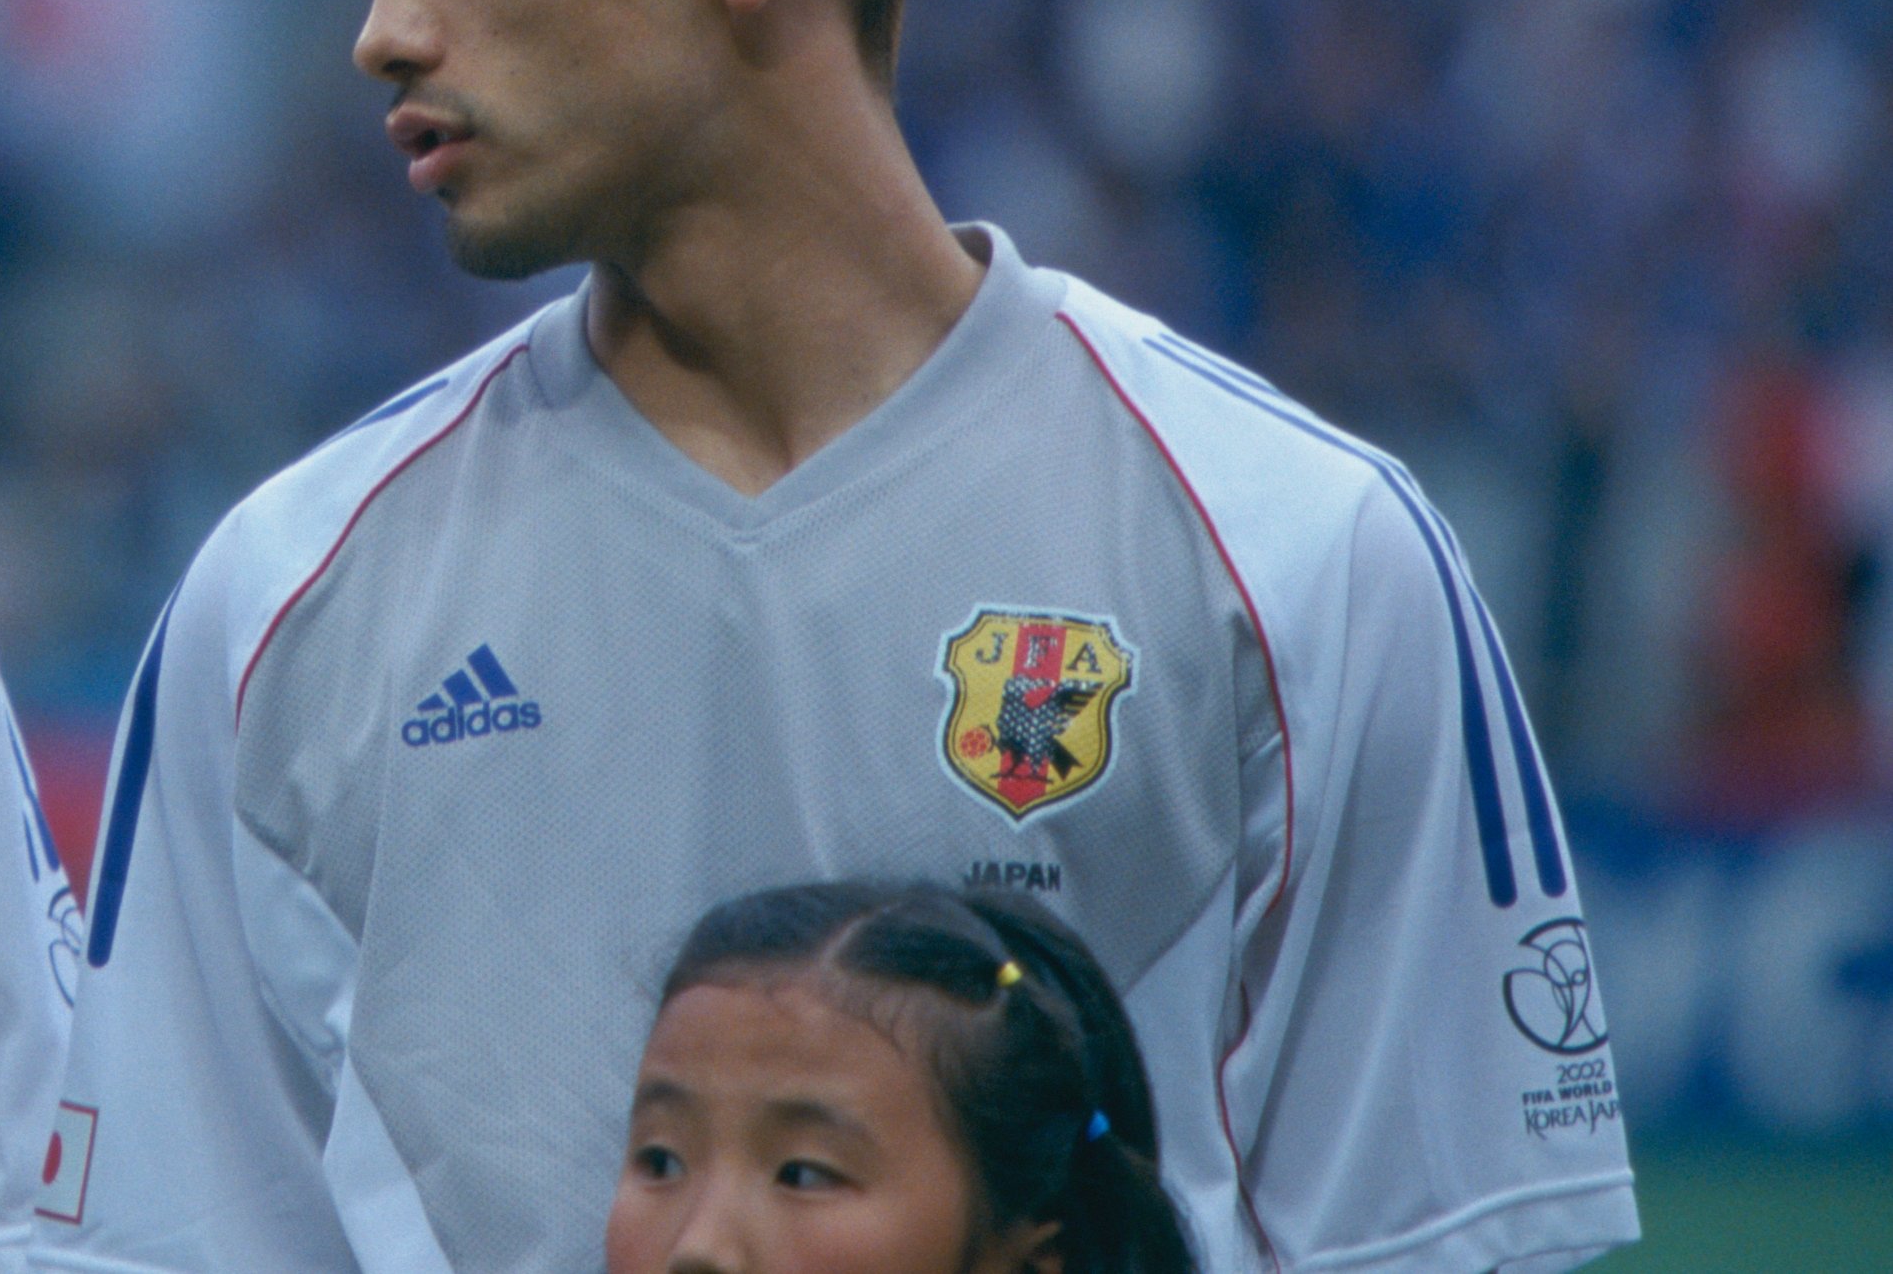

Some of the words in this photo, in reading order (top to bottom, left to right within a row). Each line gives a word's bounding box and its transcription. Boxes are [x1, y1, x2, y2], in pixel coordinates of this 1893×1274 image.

[401, 700, 542, 747] adidas
[964, 860, 1062, 892] JAPAN
[1556, 1058, 1606, 1084] 2002
[1522, 1090, 1555, 1106] FIFA
[1559, 1080, 1612, 1101] WORLD
